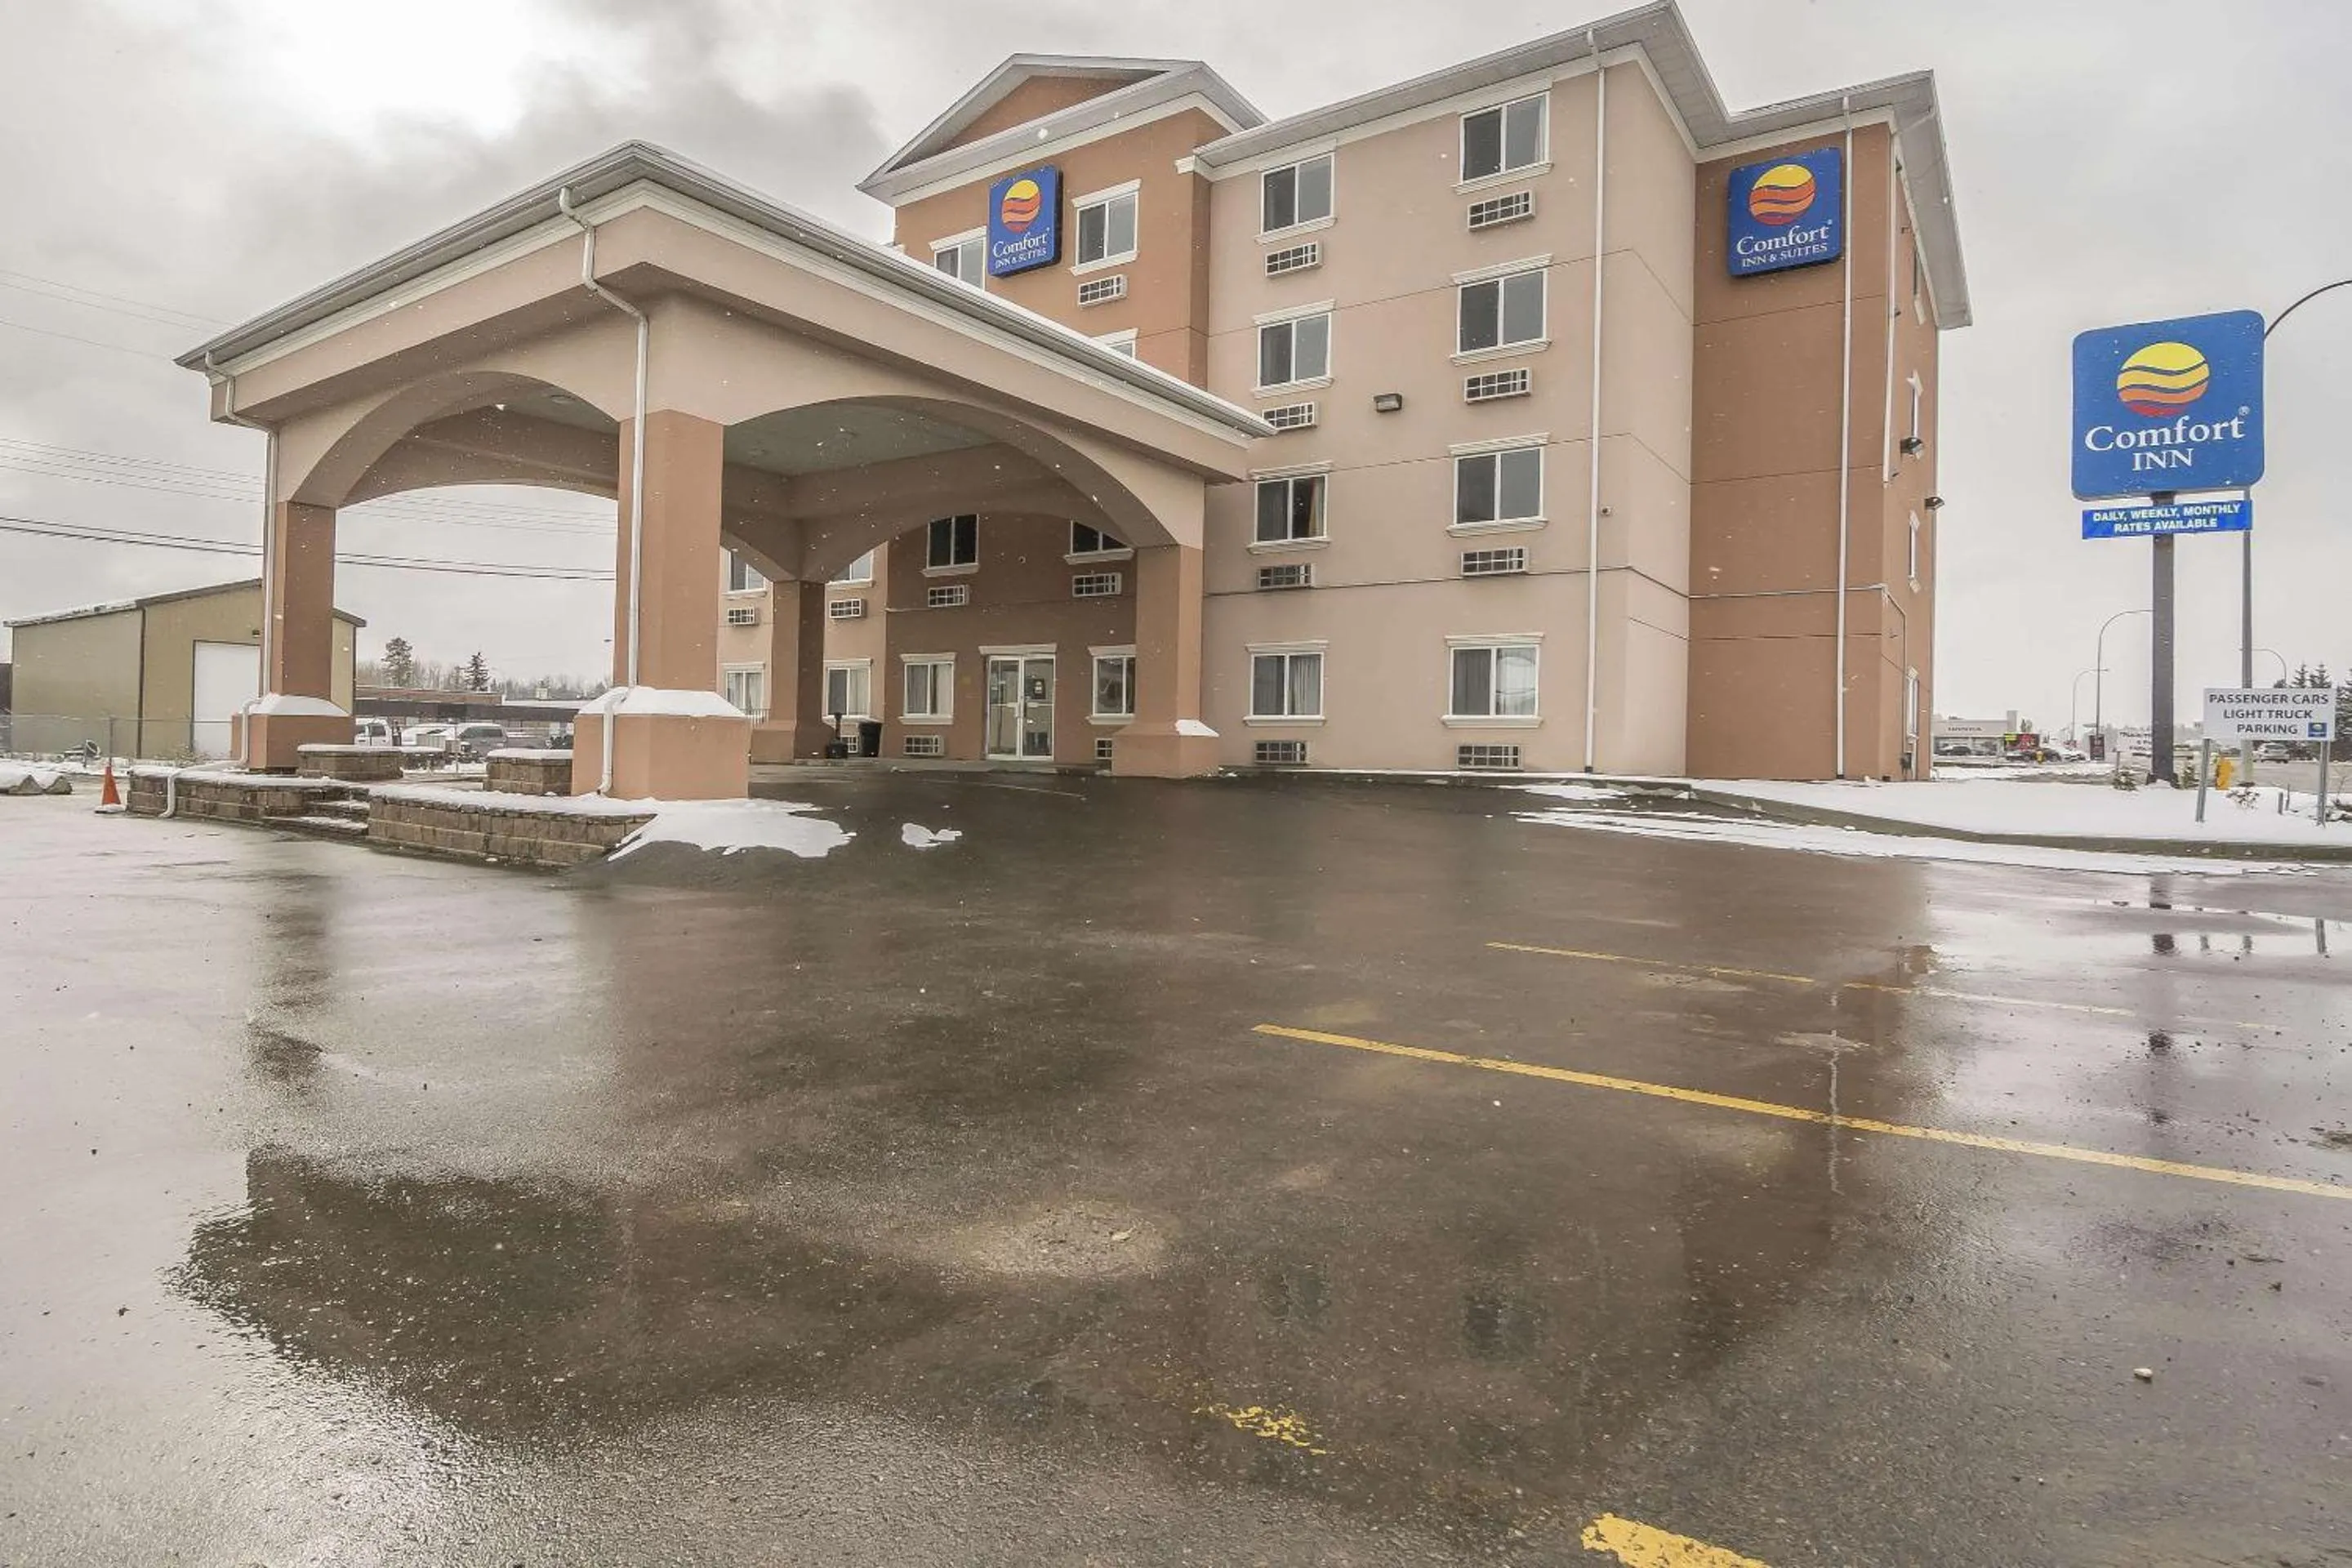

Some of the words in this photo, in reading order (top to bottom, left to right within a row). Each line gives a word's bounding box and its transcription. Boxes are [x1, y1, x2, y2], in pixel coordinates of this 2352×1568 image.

[992, 232, 1047, 258] Comfort
[1736, 225, 1829, 255] Comfort
[1742, 255, 1767, 267] INN
[1770, 253, 1777, 262] &
[1780, 243, 1828, 260] SUITES
[2084, 416, 2246, 452] Comfort
[2132, 448, 2194, 471] INN
[2092, 511, 2127, 523] DAILY,
[2131, 507, 2180, 519] WEEKLY,
[2183, 503, 2241, 517] MONTHLY
[2114, 521, 2150, 533] RATES
[2154, 518, 2217, 531] AVAILABLE
[2208, 694, 2288, 704] PASSENGER
[2292, 694, 2329, 704] CARS
[2223, 709, 2264, 719] LIGHT
[2267, 709, 2313, 719] TRUCK
[2237, 724, 2298, 734] PARKING
